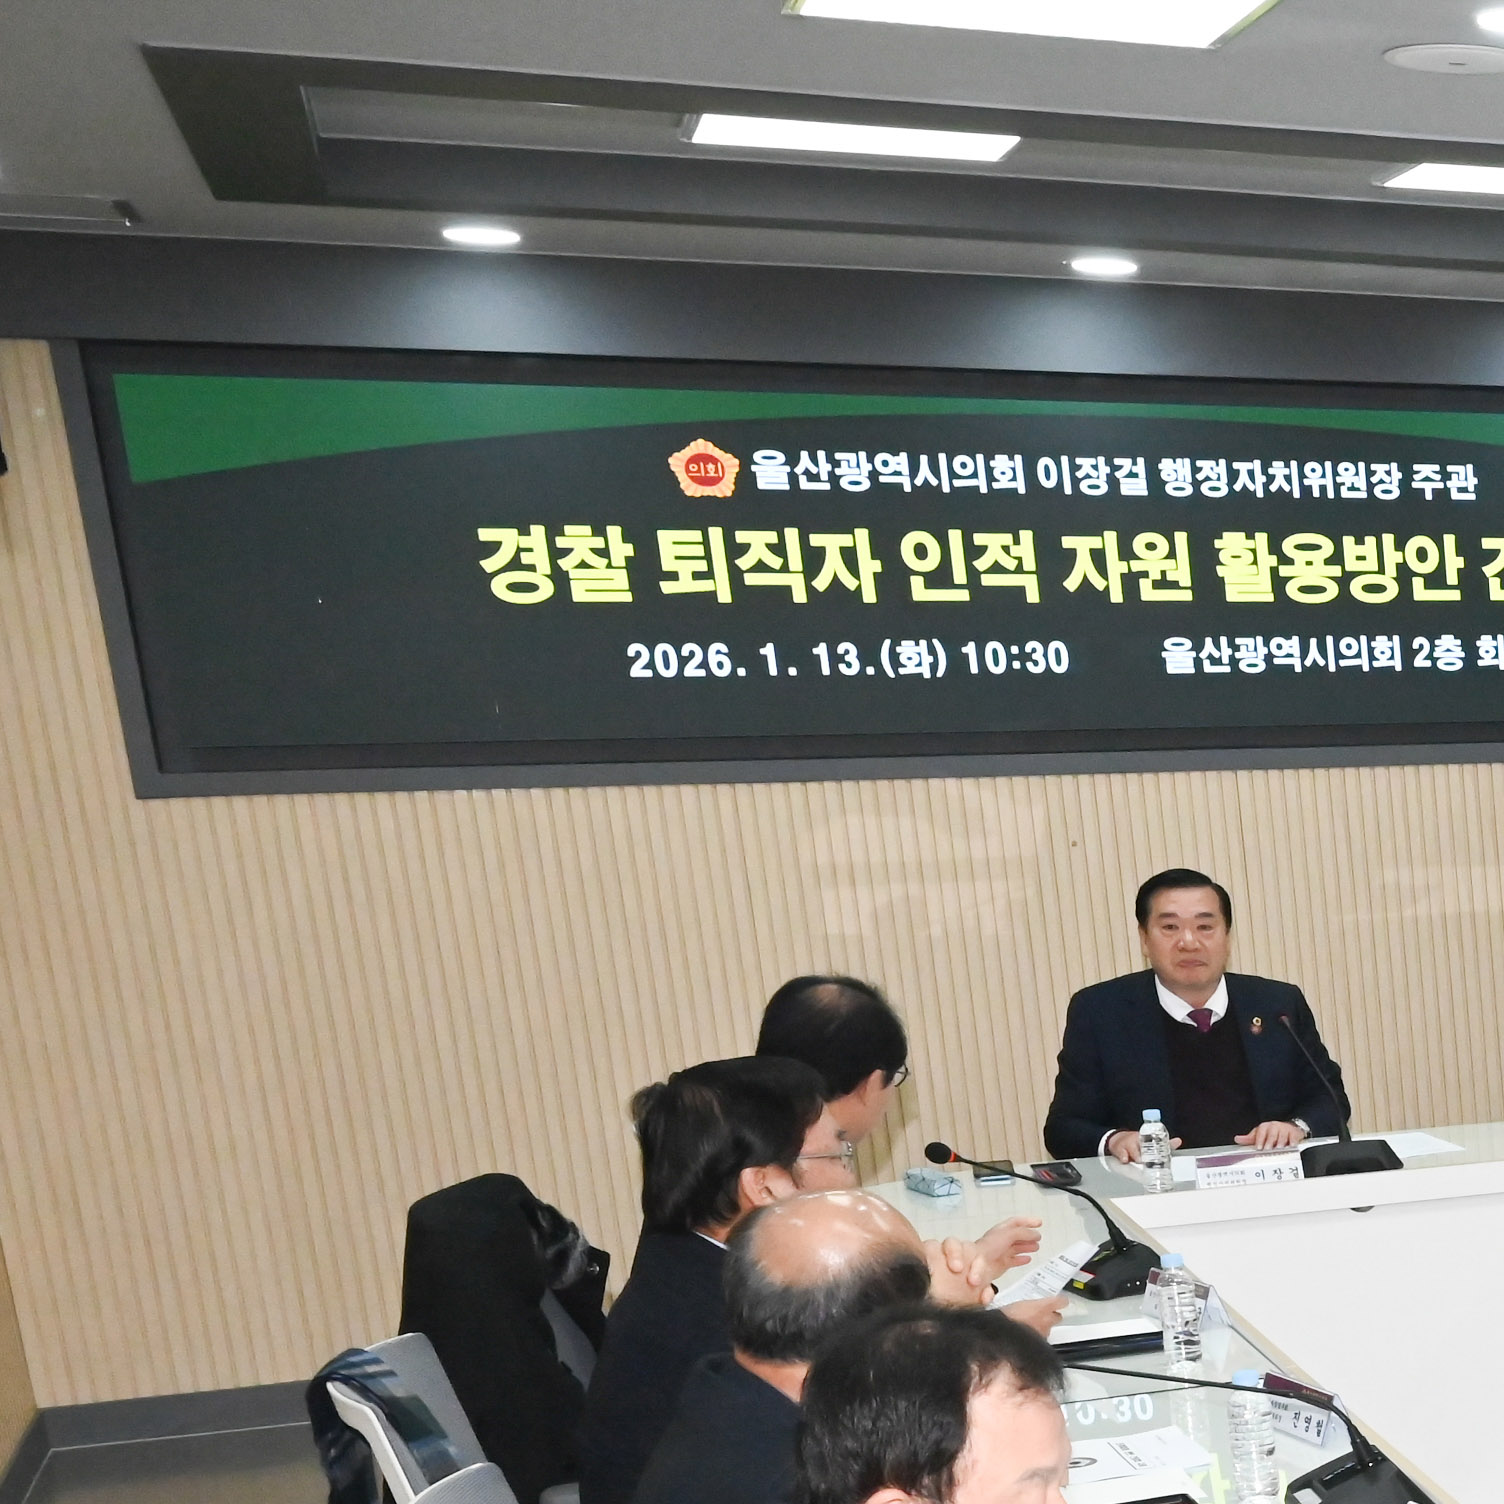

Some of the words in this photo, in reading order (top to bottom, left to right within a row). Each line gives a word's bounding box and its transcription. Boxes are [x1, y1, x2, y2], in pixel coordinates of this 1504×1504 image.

[687, 461, 723, 478] 의회
[751, 449, 1027, 496] 울산광역시의회
[1037, 454, 1148, 497] 이장걸
[1157, 457, 1403, 501] 행정자치위원장
[1411, 463, 1479, 501] 주관
[477, 524, 635, 605] 경찰
[656, 526, 883, 604] 퇴직자
[900, 528, 1041, 604] 인적
[1060, 530, 1194, 604] 자원
[1213, 531, 1465, 604] 활용방안
[626, 642, 747, 678] 2026.
[760, 642, 798, 677] 1.
[812, 639, 947, 679] 13.(화)
[960, 640, 1070, 675] 10:30
[1161, 635, 1403, 674] 울산광역시의회
[1411, 636, 1468, 672] 2층
